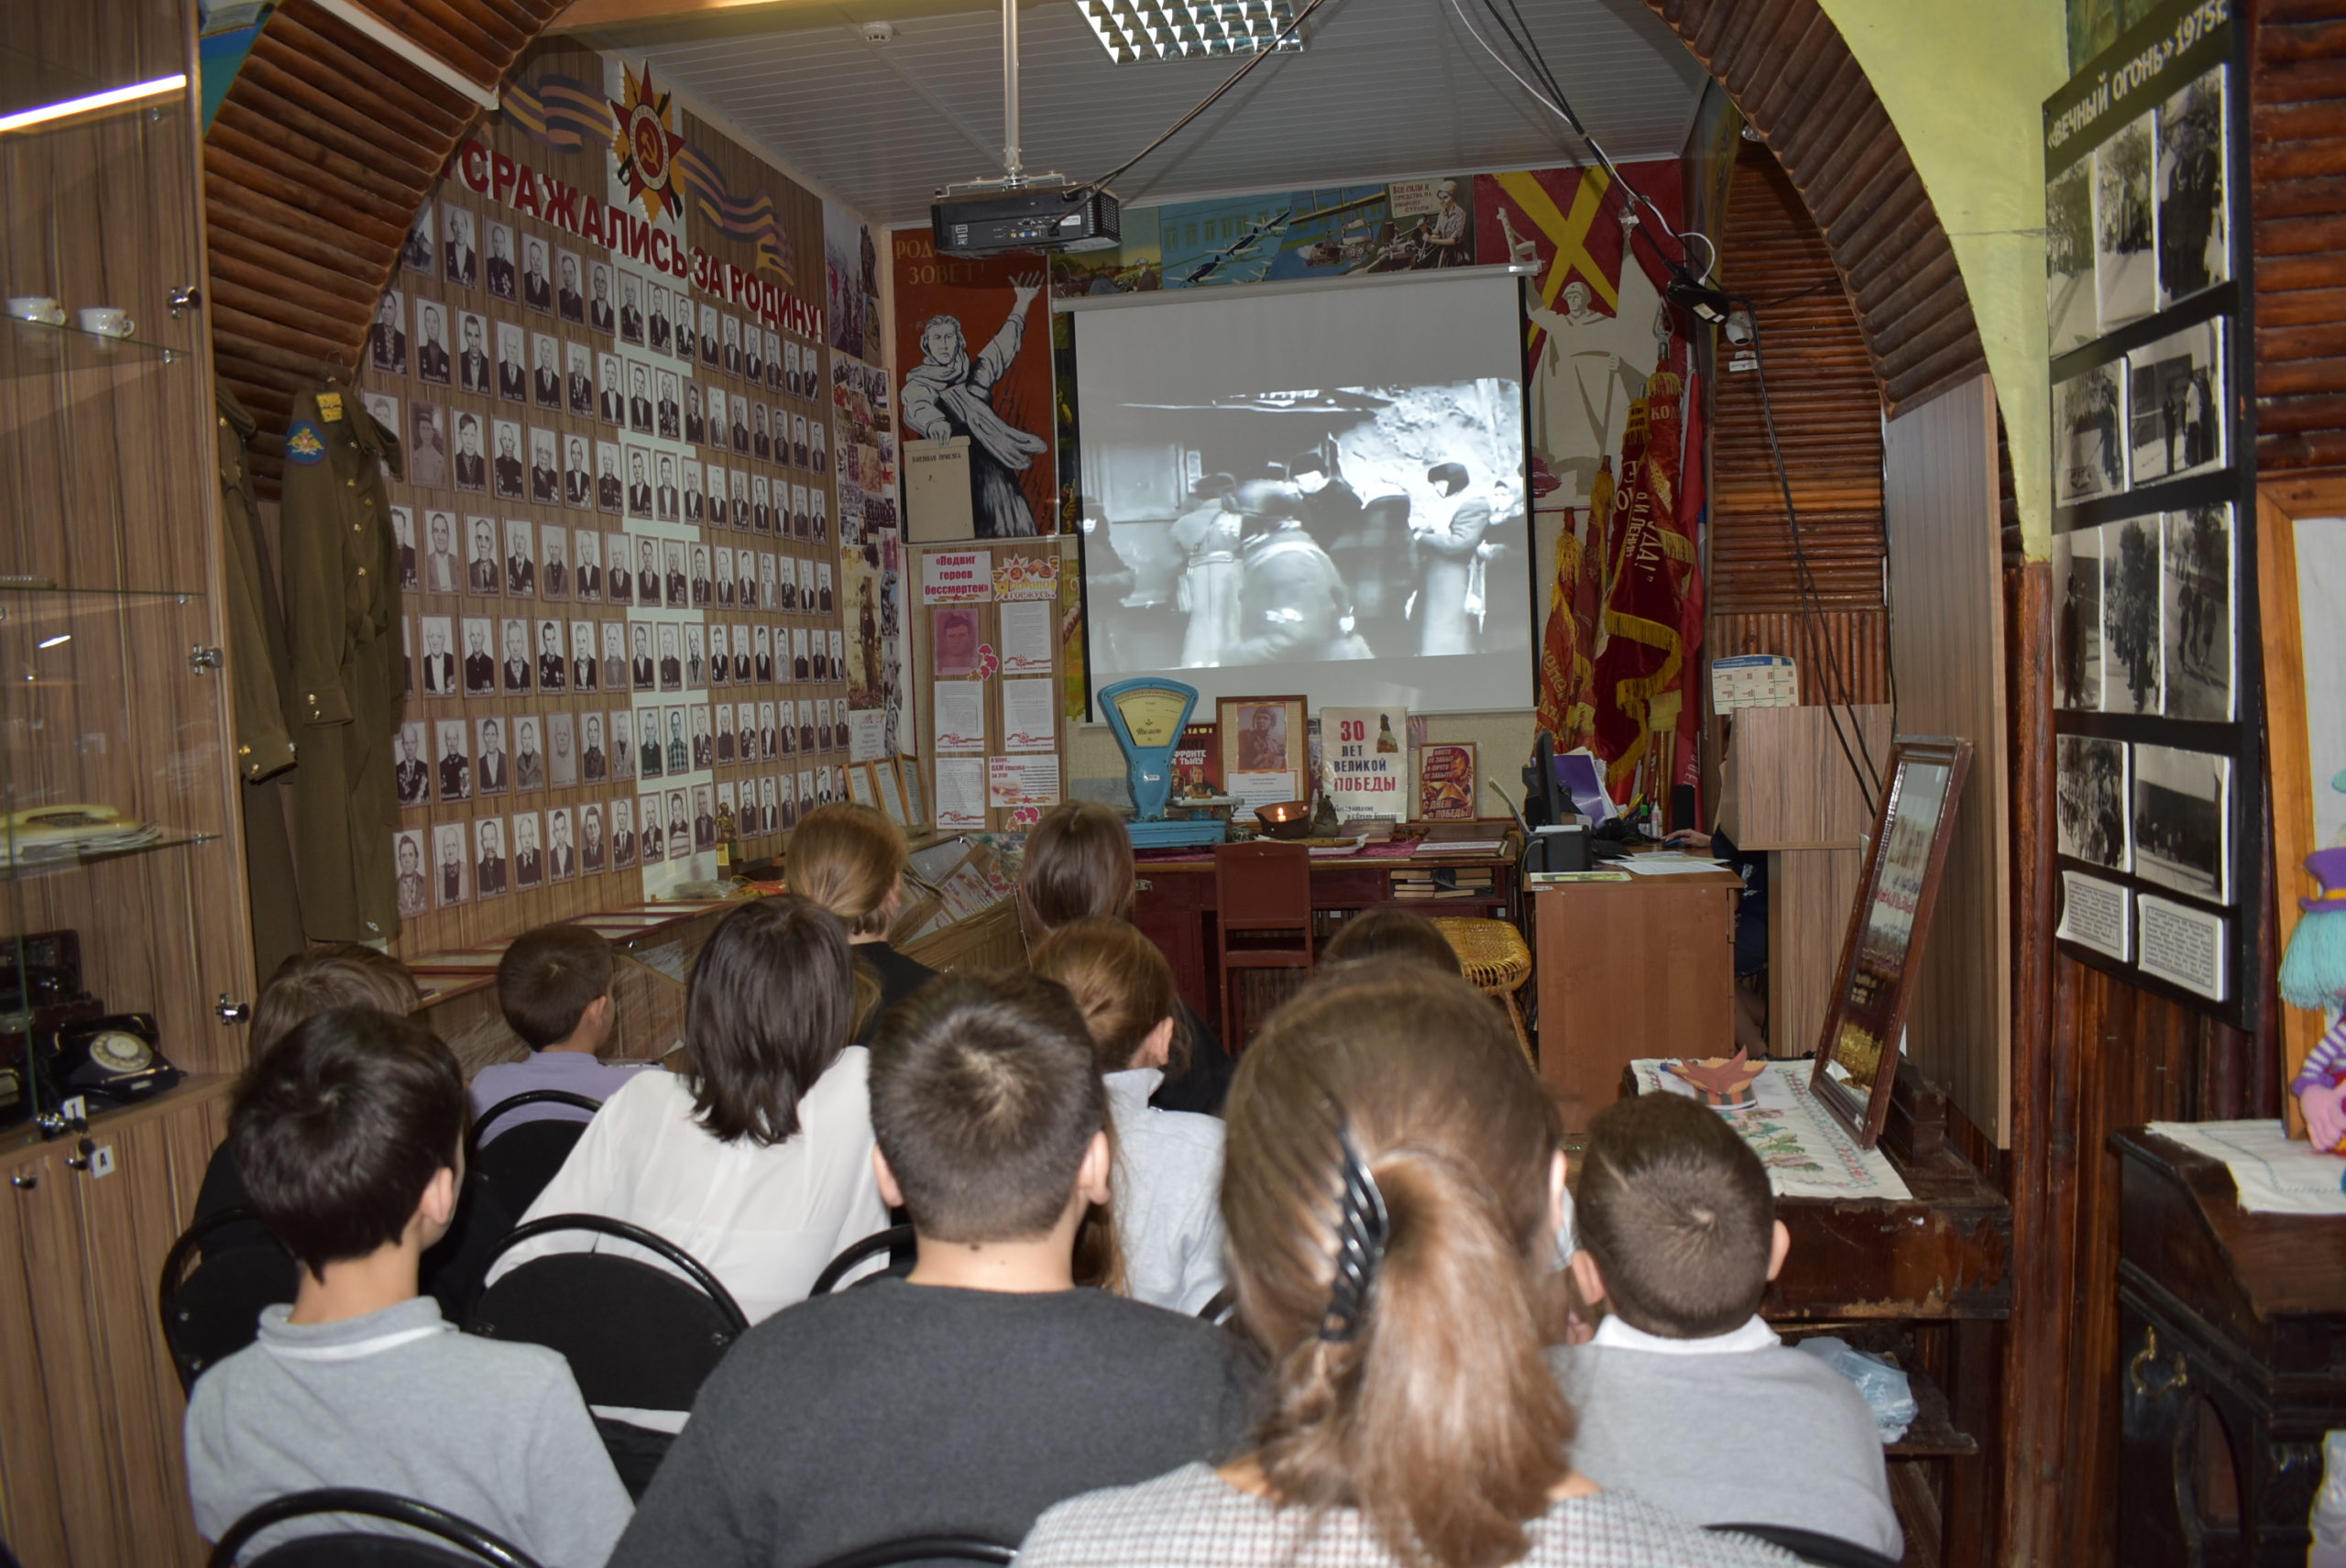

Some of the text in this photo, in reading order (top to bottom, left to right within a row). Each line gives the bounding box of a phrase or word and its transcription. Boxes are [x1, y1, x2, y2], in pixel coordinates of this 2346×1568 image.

[2047, 71, 2108, 149] «ВЕЧНЫЙ
[2112, 38, 2173, 101] ОГОНЬ»
[458, 138, 688, 280] СРАЖАЛИСЬ
[689, 246, 725, 300] ЗА
[726, 264, 825, 345] РОДИНУ!
[936, 556, 977, 567] «Подвиг
[939, 570, 973, 582] героев
[925, 584, 989, 596] бессмертен»
[1340, 720, 1365, 741] 30
[1342, 745, 1364, 757] ЛЕТ
[1178, 757, 1204, 765] ТЫЛУ
[1333, 758, 1387, 773] ВЕЛИКОЙ
[1333, 776, 1397, 793] ПОБЕДЫ
